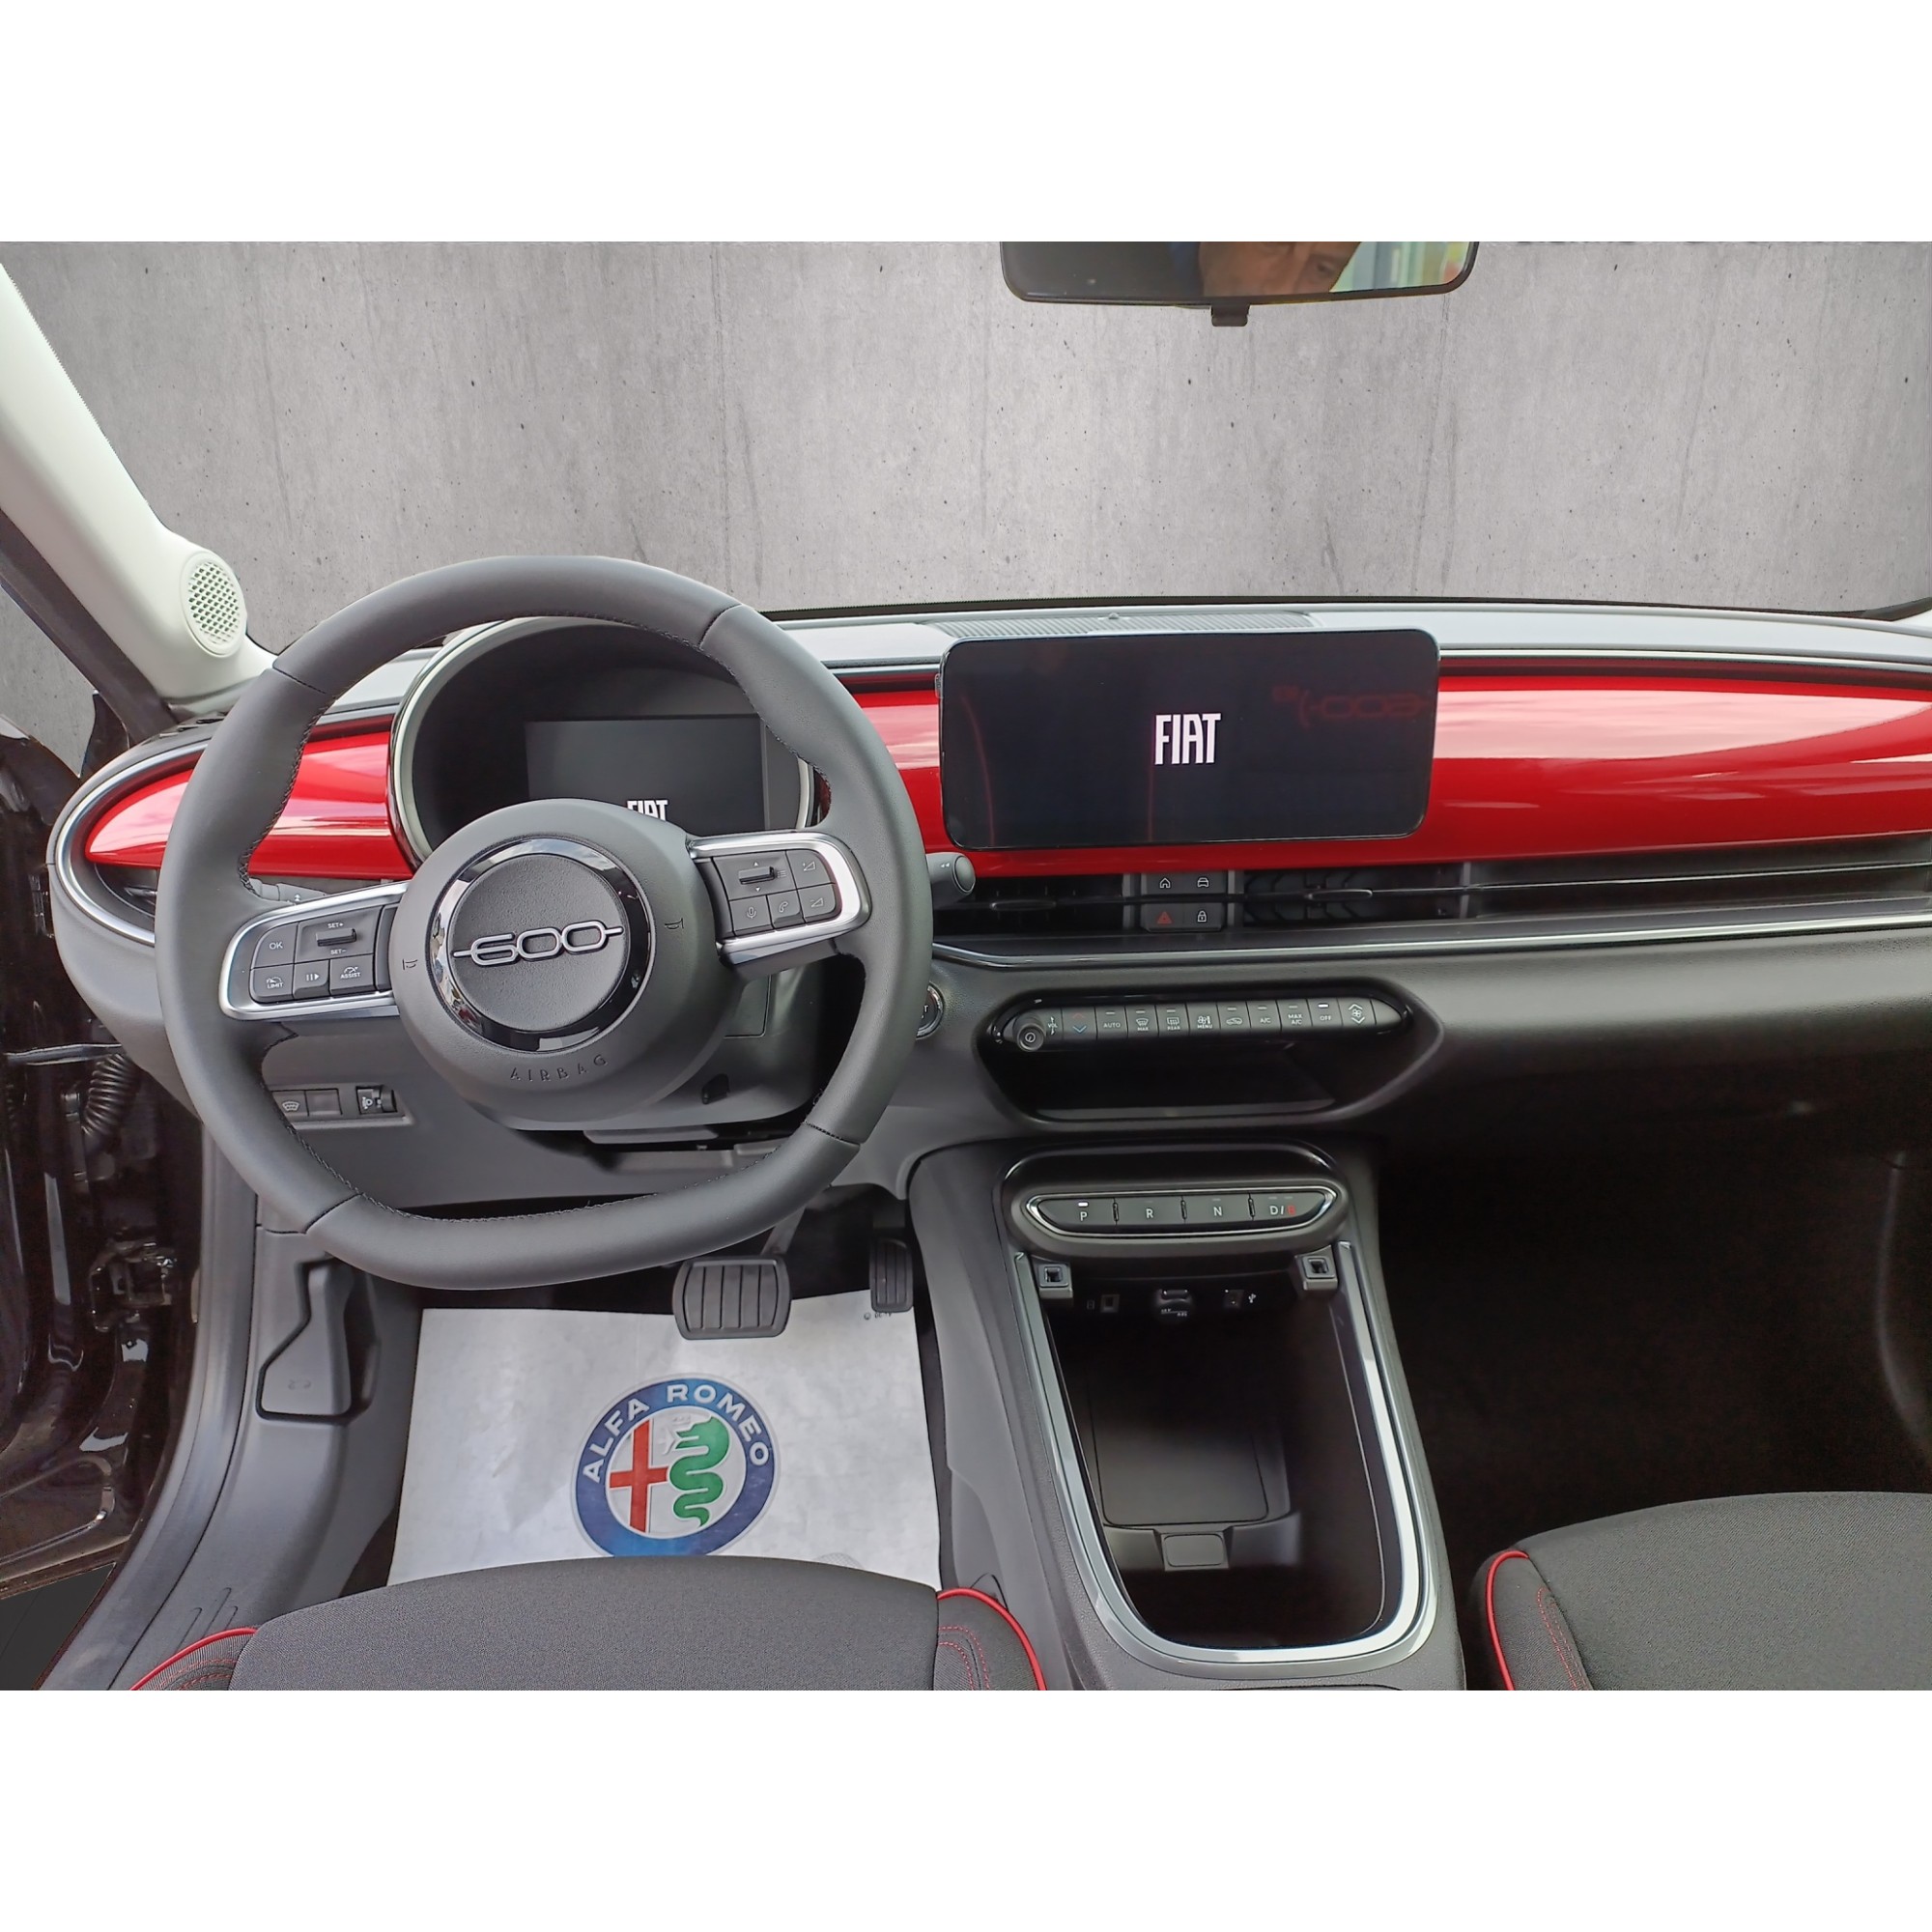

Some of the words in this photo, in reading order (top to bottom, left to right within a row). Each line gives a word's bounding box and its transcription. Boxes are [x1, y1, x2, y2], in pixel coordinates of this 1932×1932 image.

[1154, 713, 1222, 765] FIAT
[269, 941, 284, 951] OK
[453, 920, 624, 966] 600
[340, 971, 361, 980] ASSIST
[267, 980, 284, 989] LIMIT
[1260, 1016, 1271, 1025] A/C
[509, 1054, 609, 1082] AIRBAG
[1079, 1210, 1089, 1222] P
[1146, 1208, 1155, 1219] R
[1213, 1206, 1223, 1217] N
[582, 1398, 650, 1484] ALFA
[667, 1384, 770, 1466] ROMEO
